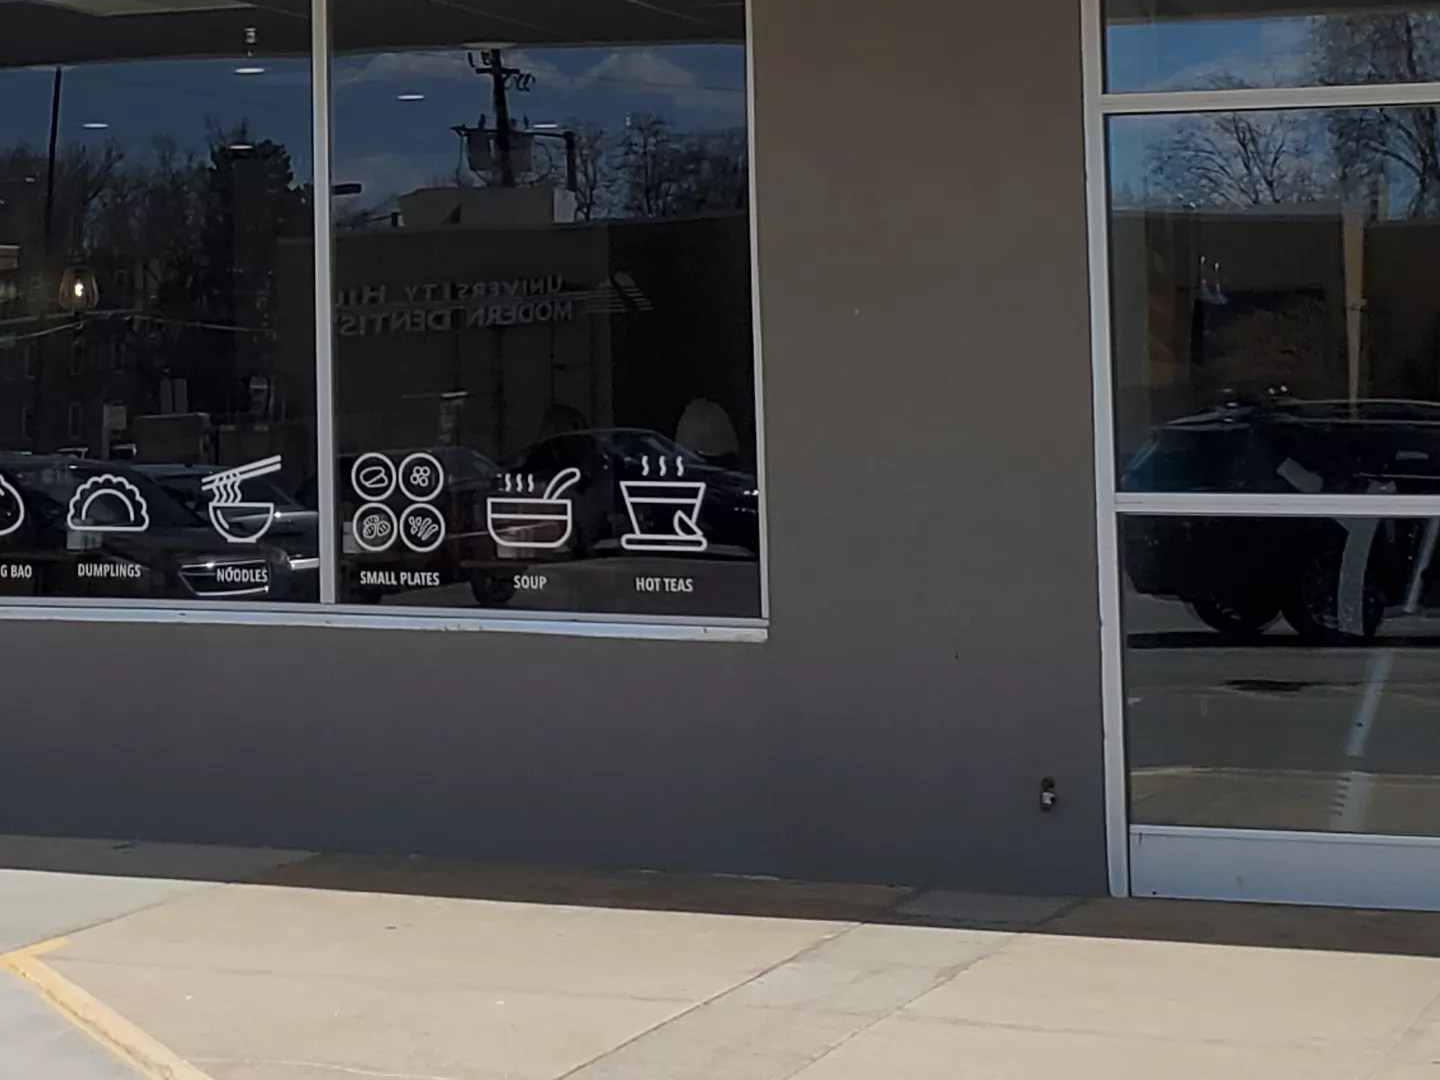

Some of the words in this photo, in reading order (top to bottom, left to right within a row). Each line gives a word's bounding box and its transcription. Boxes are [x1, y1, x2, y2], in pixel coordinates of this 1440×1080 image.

[10, 565, 33, 579] BAO
[77, 563, 141, 579] DUMPLINGS
[216, 567, 268, 583] NOODLES
[360, 571, 397, 586] SMALL
[400, 571, 440, 587] PLATES
[513, 575, 547, 590] SOUP
[635, 576, 661, 592] HOT
[663, 577, 694, 593] TEAS
